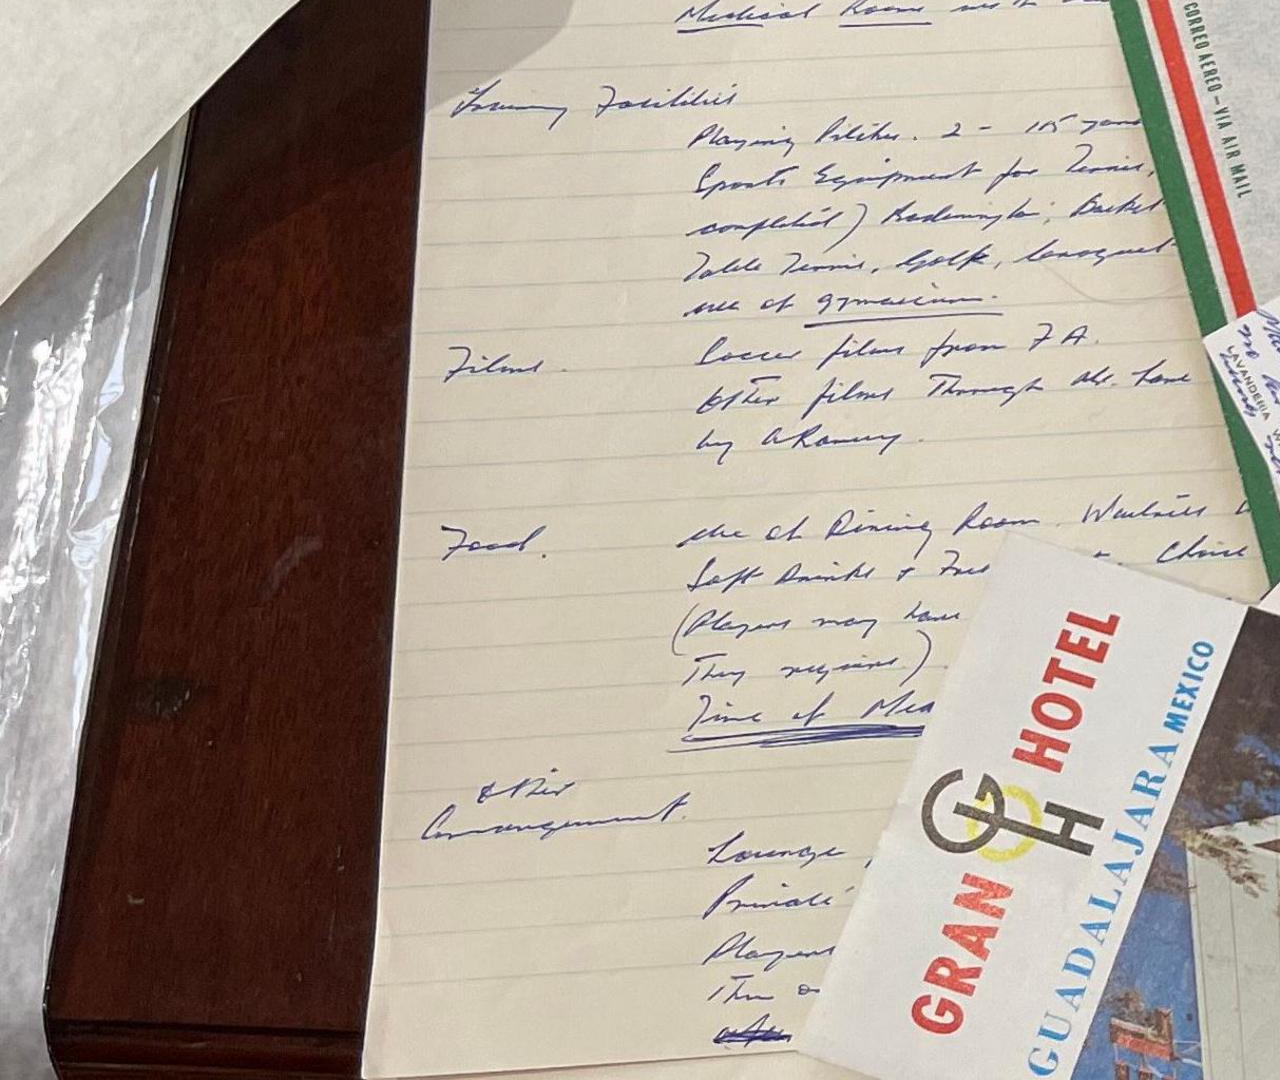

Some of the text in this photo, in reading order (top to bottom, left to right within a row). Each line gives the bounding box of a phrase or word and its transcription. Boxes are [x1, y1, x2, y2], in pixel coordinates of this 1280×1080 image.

[1183, 2, 1253, 199] CORREO AEREO VIA AIR MAIL
[1226, 344, 1271, 421] LAVANDERIA
[911, 609, 1121, 1036] GRAN HOTEL
[1026, 639, 1216, 1080] GUADALAJARA MEXICO
